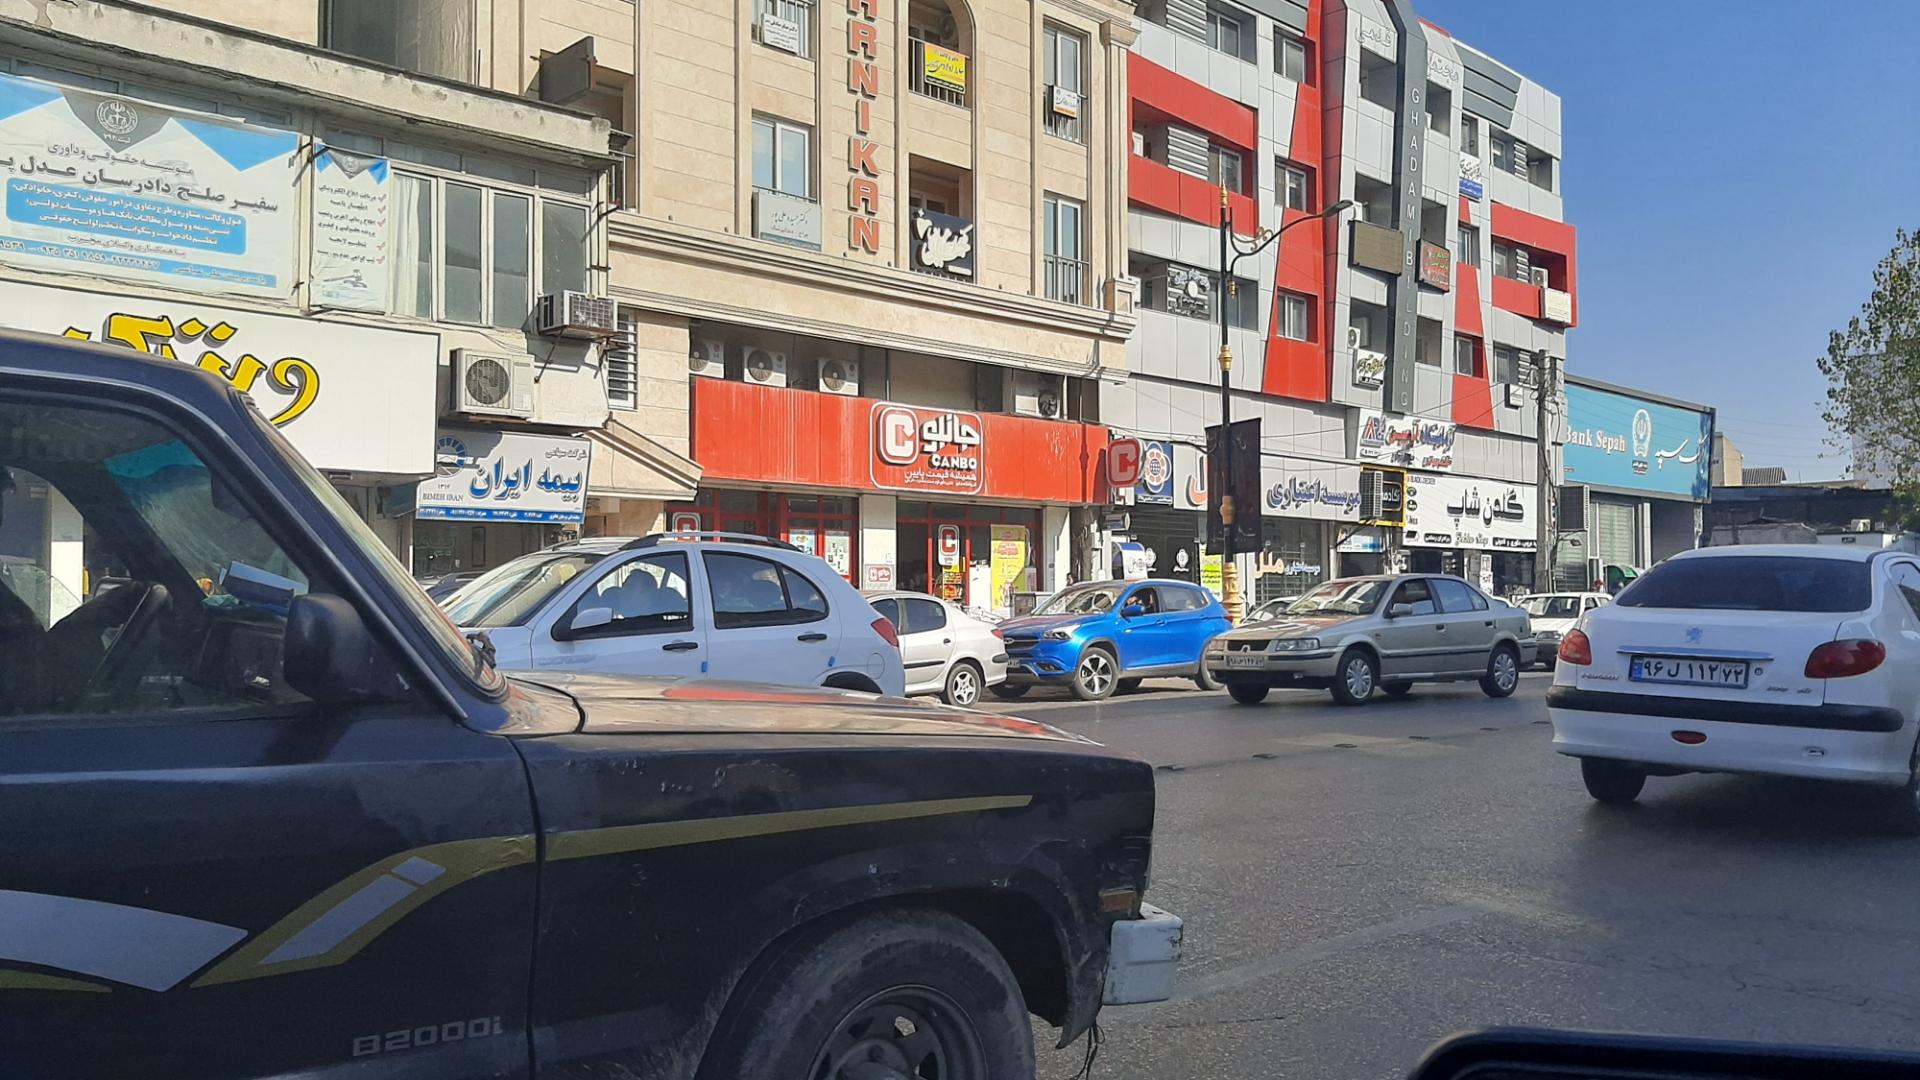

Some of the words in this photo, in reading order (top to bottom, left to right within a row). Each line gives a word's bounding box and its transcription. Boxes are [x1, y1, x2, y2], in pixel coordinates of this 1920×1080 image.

[47, 143, 80, 156] داوری
[20, 155, 77, 176] عدل
[82, 167, 171, 194] دادرسان
[177, 186, 226, 202] صلح
[228, 196, 278, 213] سفیر
[922, 413, 980, 453] جانبو
[1595, 430, 1627, 455] Sepah
[1654, 438, 1689, 471] سپه
[469, 456, 533, 501] ایران
[536, 466, 583, 502] بیمه
[1266, 475, 1321, 509] اعتباری
[422, 493, 445, 501] BIMEH
[447, 493, 464, 502] IRAN
[1447, 486, 1480, 530] شاپ
[1483, 487, 1524, 528] گلدن
[1643, 656, 1664, 678] ۹۶
